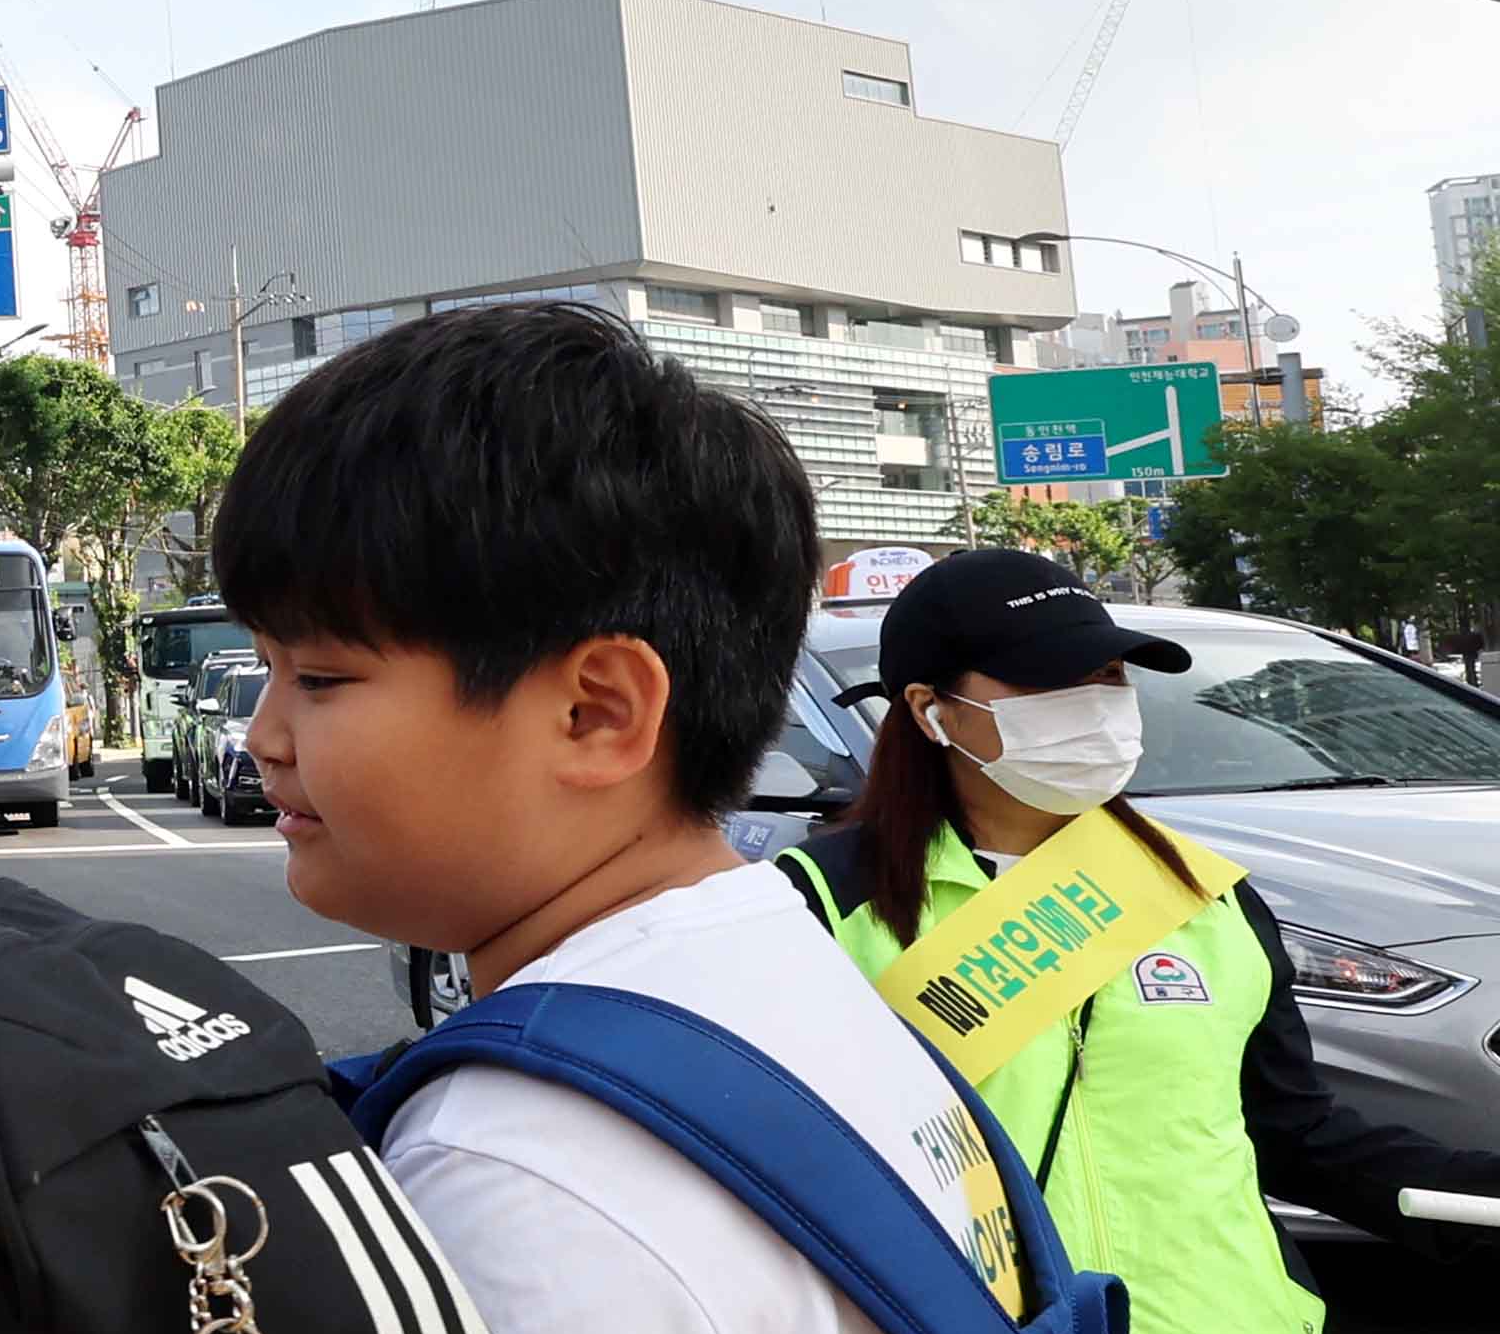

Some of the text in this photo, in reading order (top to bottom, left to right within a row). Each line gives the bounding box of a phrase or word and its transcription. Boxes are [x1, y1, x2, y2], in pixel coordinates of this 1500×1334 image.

[1021, 442, 1088, 462] 송림로
[1131, 466, 1166, 478] 150m
[1006, 595, 1035, 609] THIS
[1034, 591, 1047, 601] IS
[156, 1012, 251, 1062] adidas
[911, 1104, 989, 1193] THINK
